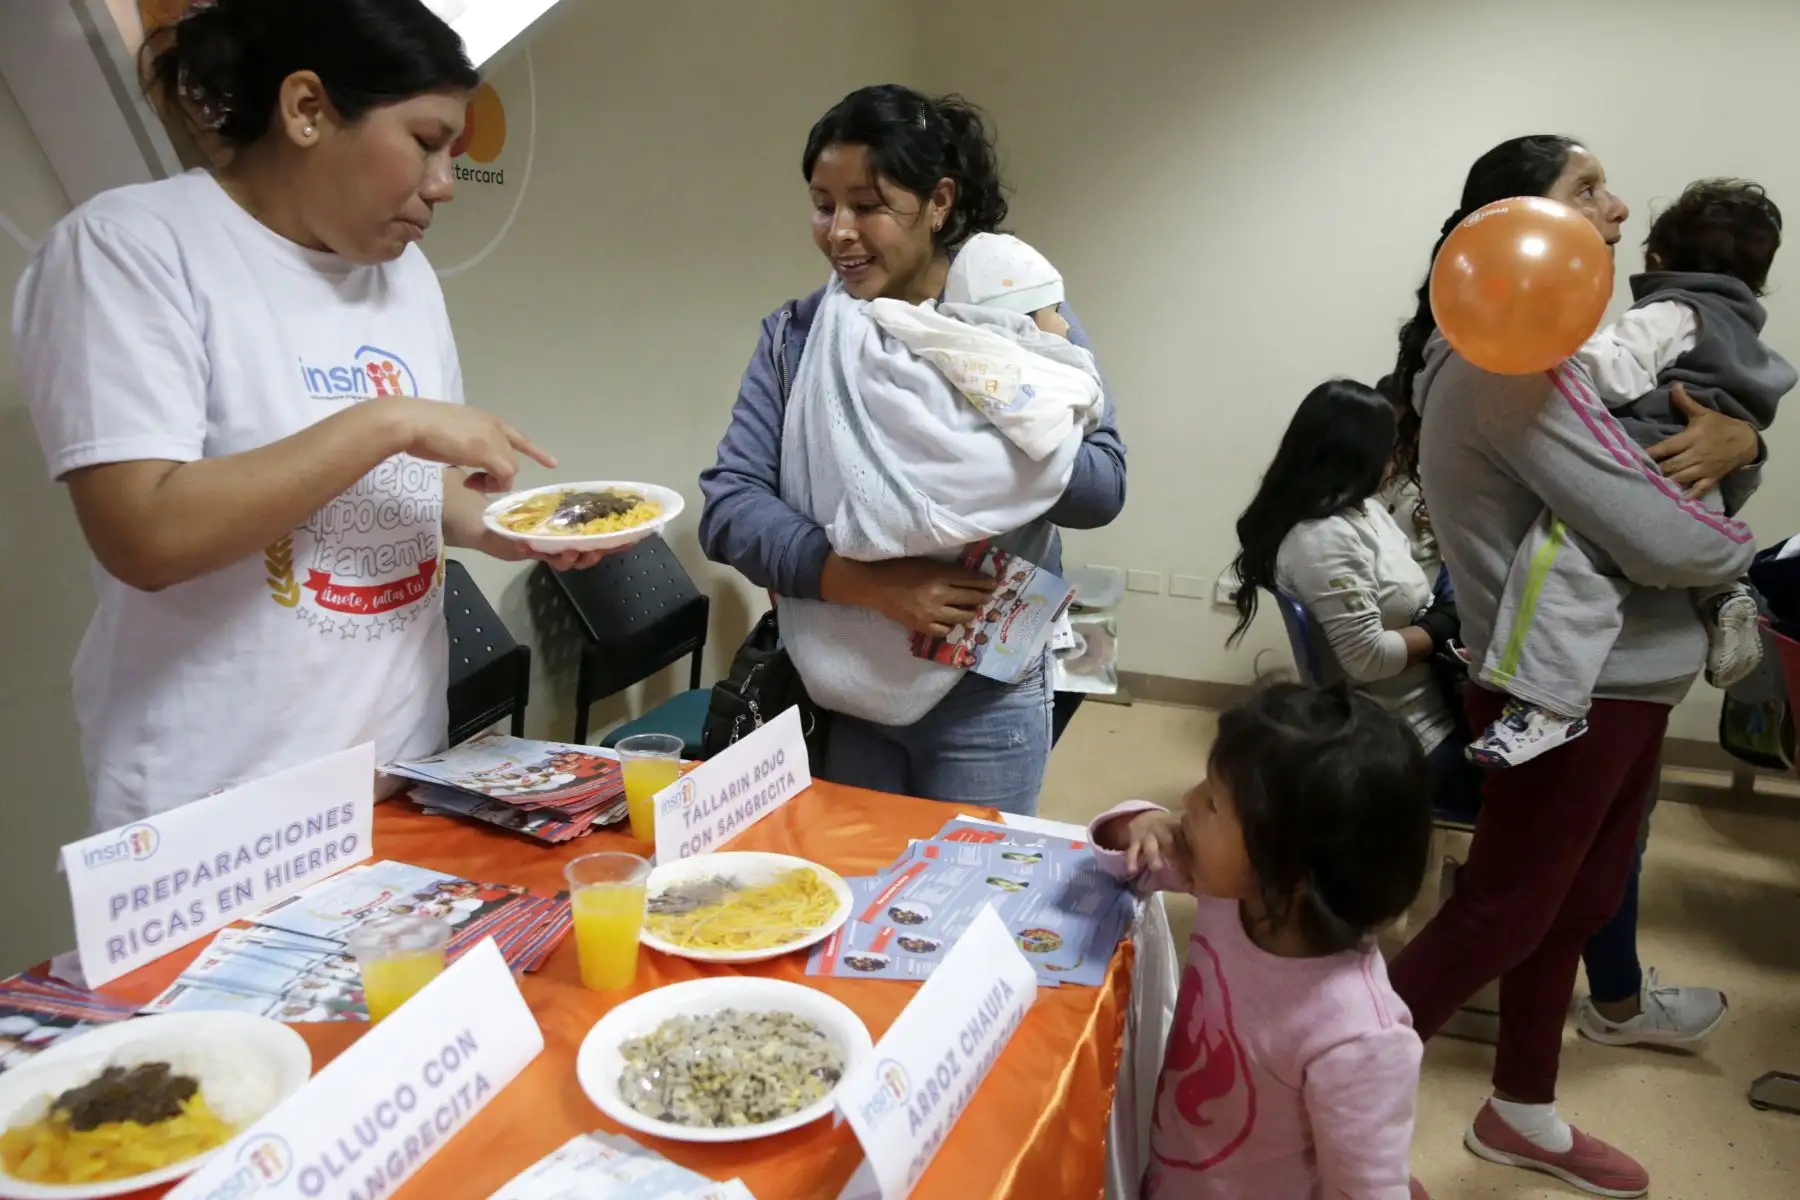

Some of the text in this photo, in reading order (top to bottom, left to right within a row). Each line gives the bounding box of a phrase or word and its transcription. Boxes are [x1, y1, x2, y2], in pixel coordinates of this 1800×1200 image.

[452, 163, 504, 185] tercard
[297, 356, 369, 394] insn
[377, 495, 442, 530] cont
[680, 772, 796, 859] CON SANGRECITA
[682, 749, 785, 829] TALLARIN ROJO
[105, 833, 359, 964] RICAS EN HIERRO
[108, 802, 356, 922] PREPARACIONES
[907, 977, 1015, 1137] ARROZ CHAUFA
[298, 1028, 480, 1197] OLLUCO CON
